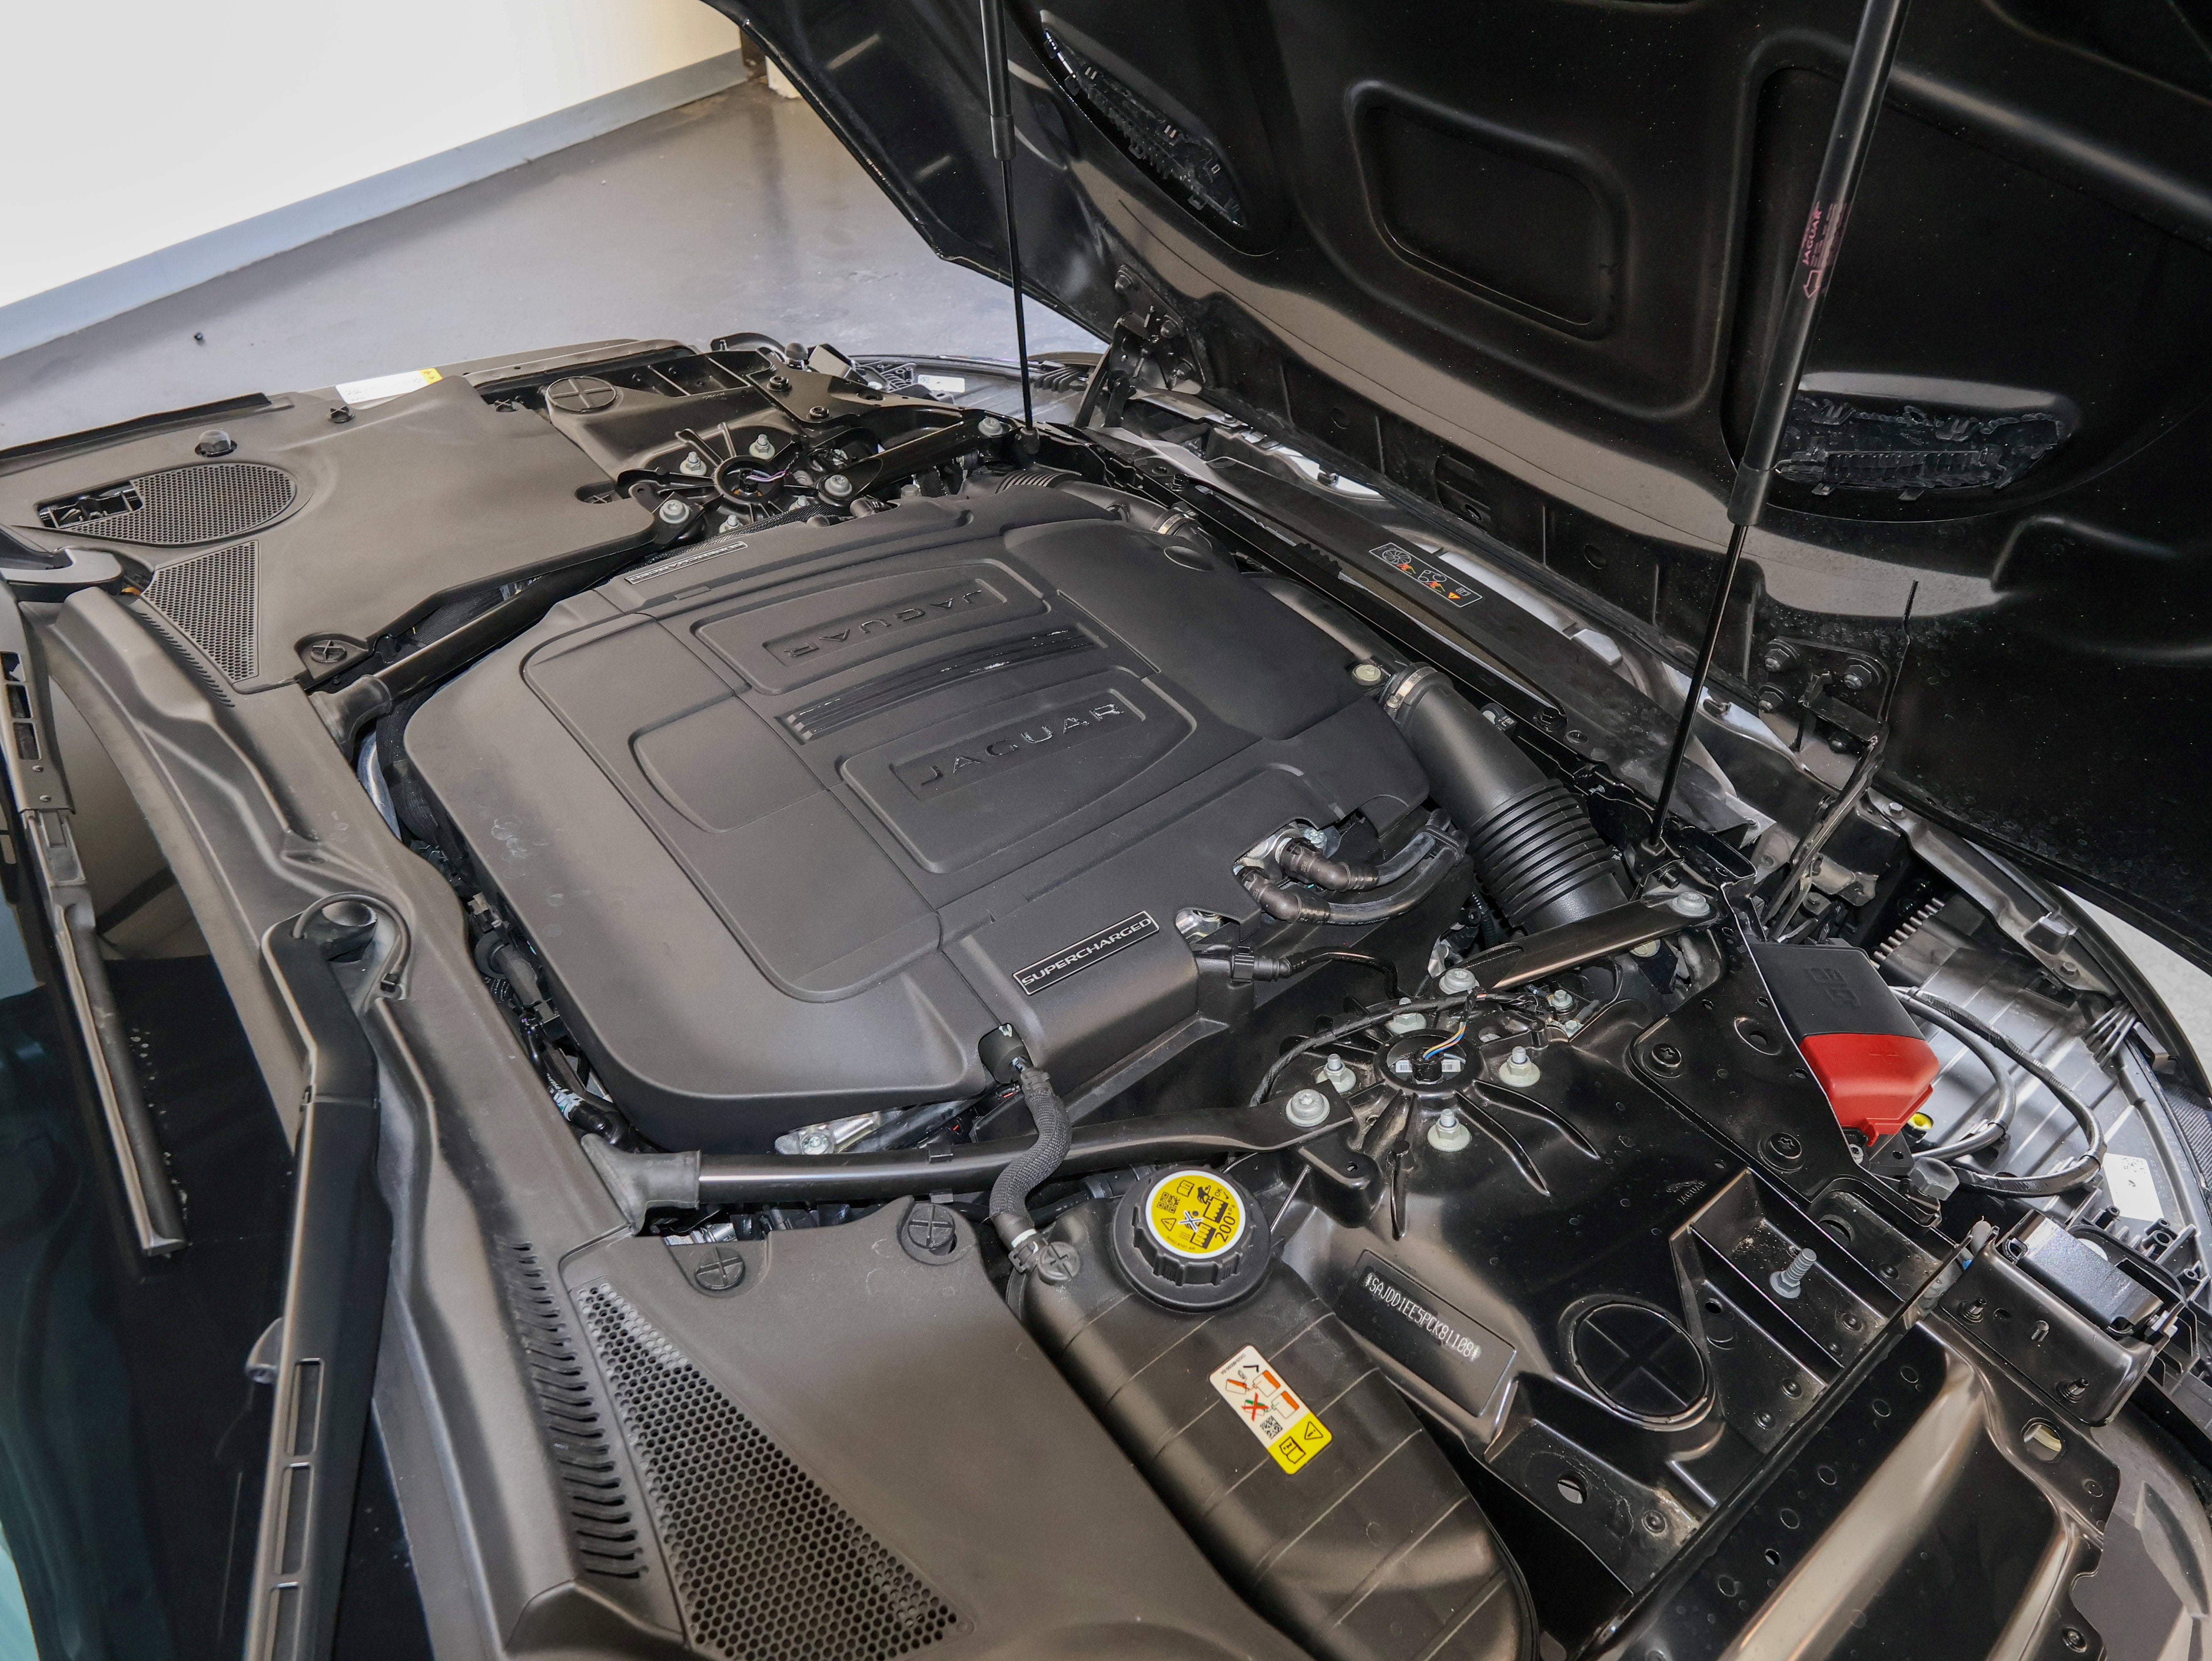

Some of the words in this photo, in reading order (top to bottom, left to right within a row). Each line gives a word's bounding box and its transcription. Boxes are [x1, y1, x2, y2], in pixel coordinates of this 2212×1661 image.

[784, 590, 982, 657] JAGUAR
[921, 703, 1124, 786] JAGUAR
[1021, 918, 1152, 986] SUPERCHARGED
[1215, 1188, 1223, 1197] OK
[1677, 1181, 1707, 1205] JAGUAR
[1215, 1215, 1235, 1243] 200
[1227, 1205, 1236, 1215] kPa
